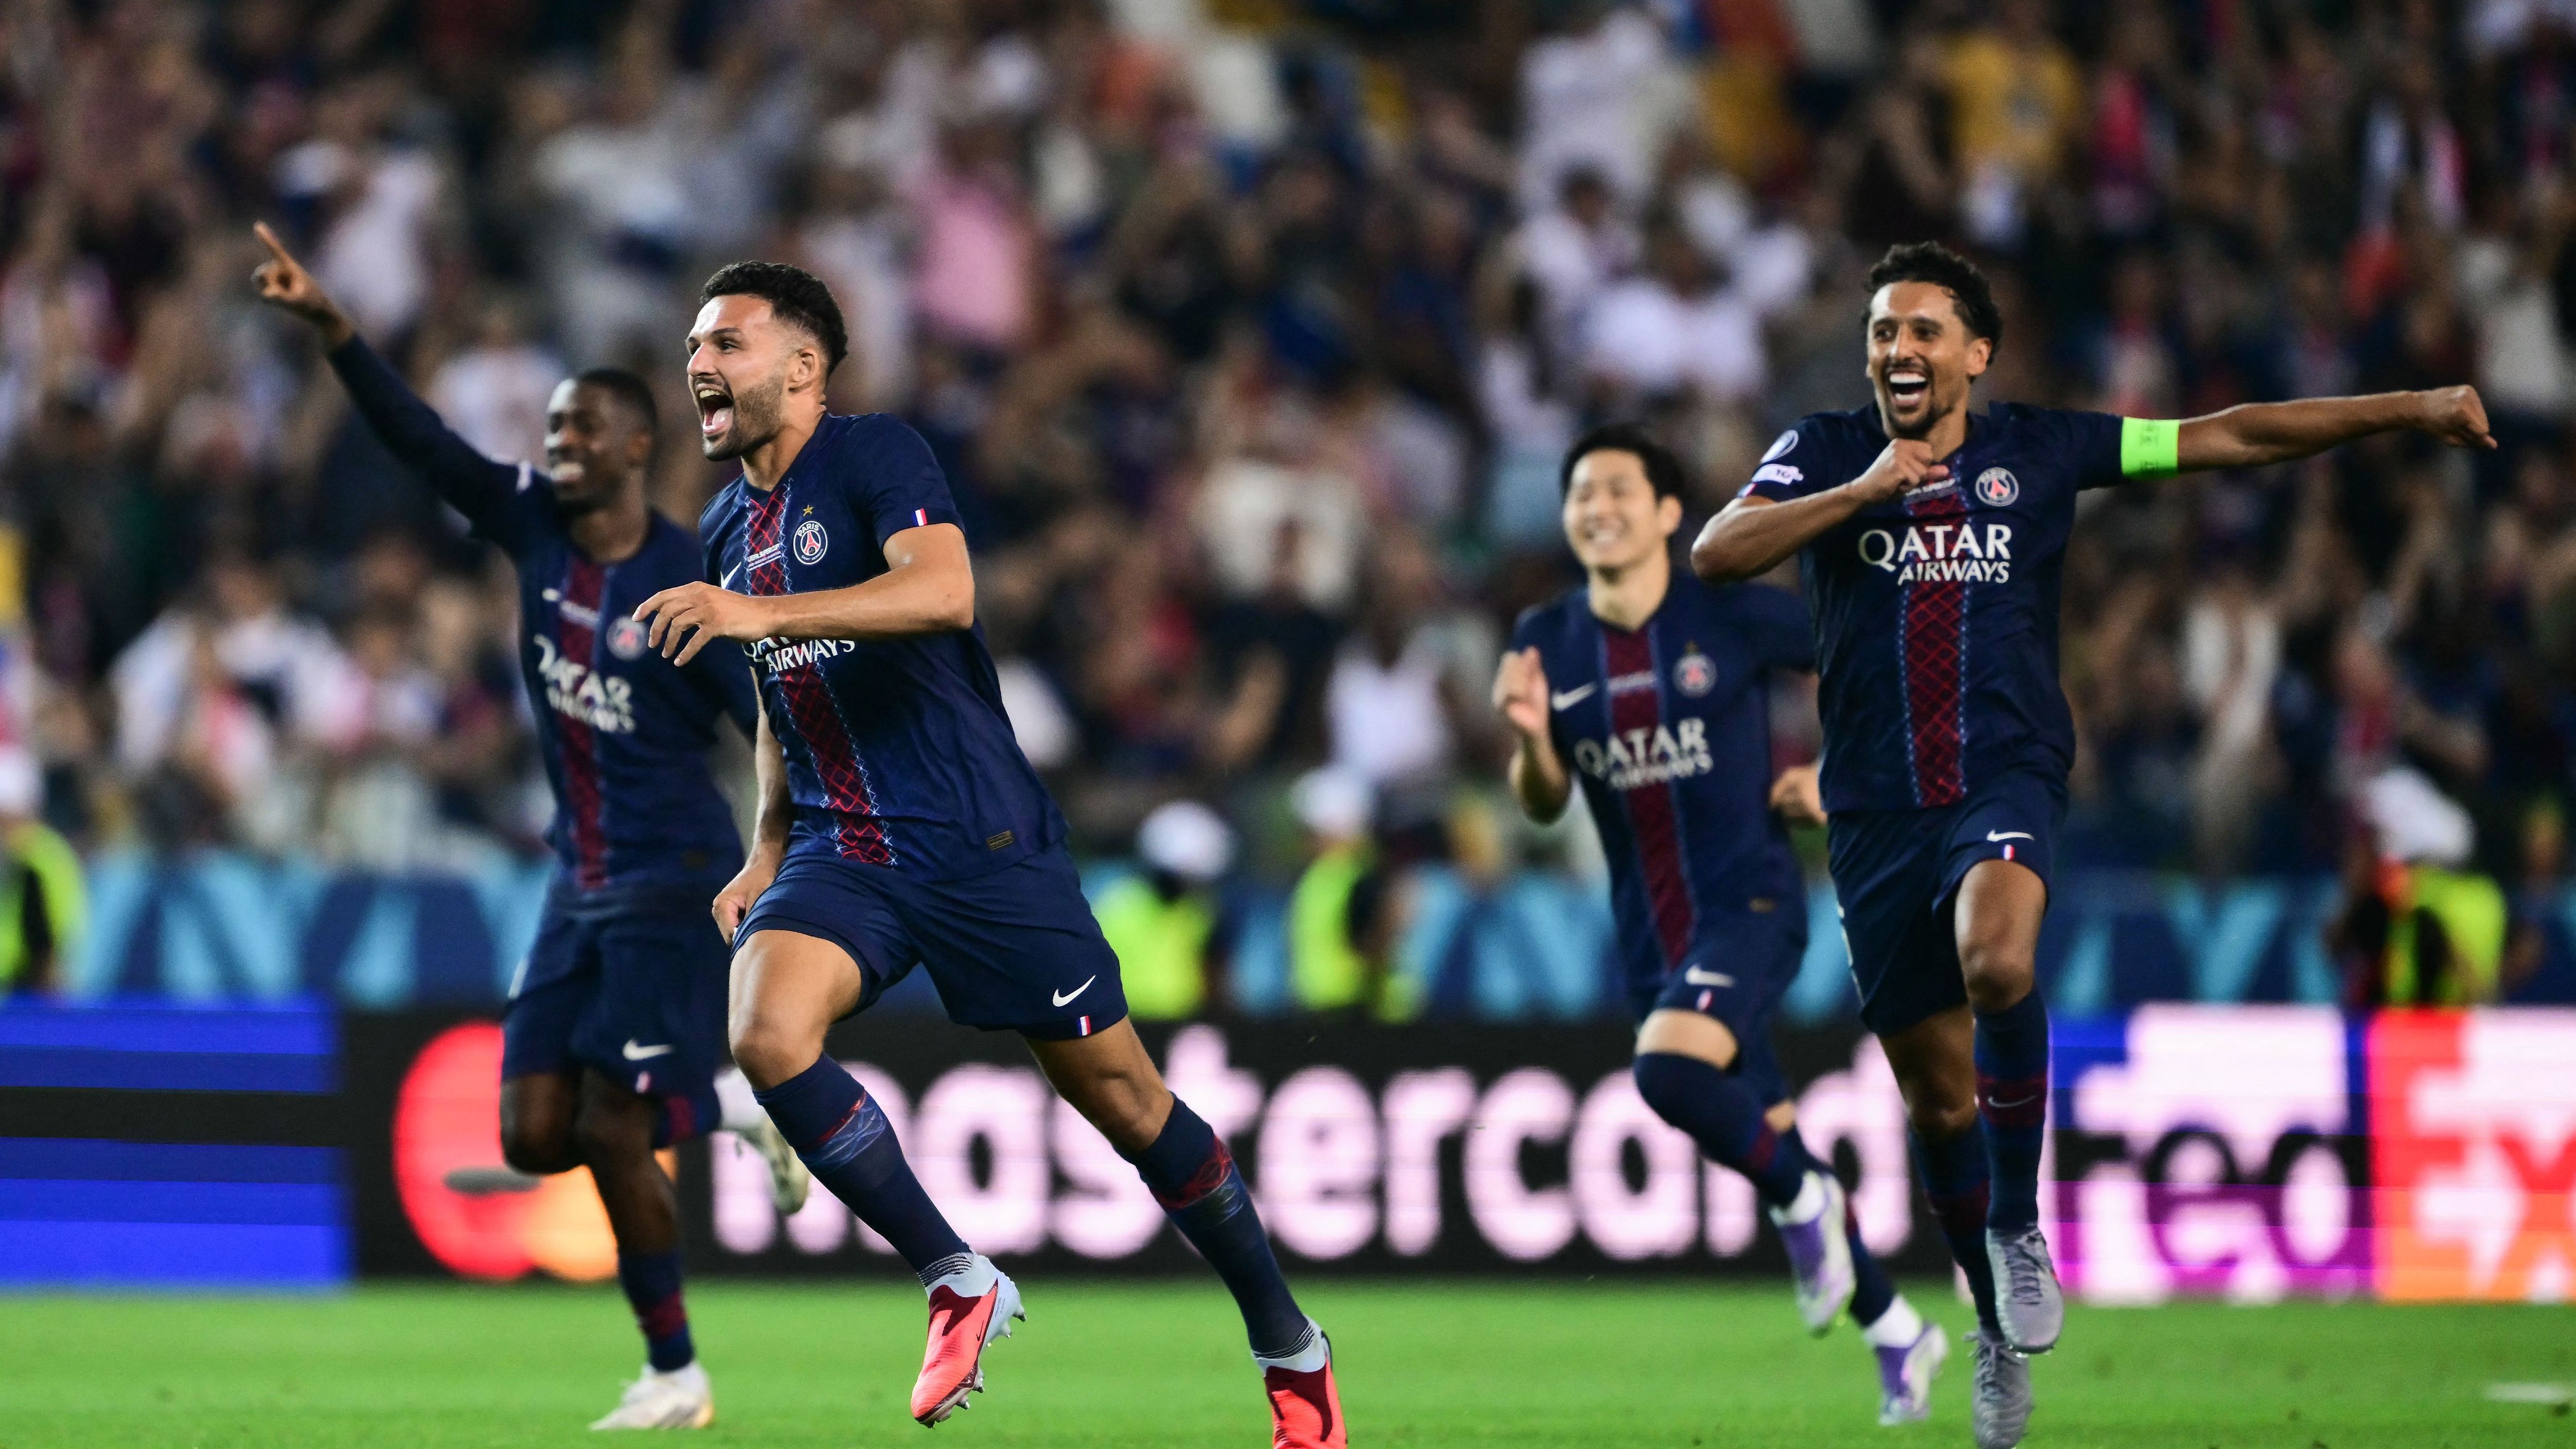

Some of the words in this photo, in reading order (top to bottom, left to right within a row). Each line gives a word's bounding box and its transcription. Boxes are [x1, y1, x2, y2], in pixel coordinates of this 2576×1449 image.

[797, 523, 820, 537] PARIS
[1858, 523, 2012, 572] QATAR
[1897, 559, 2010, 586] AIRWAYS
[765, 639, 855, 673] AIRWAYS
[1574, 717, 1709, 780] QATAR
